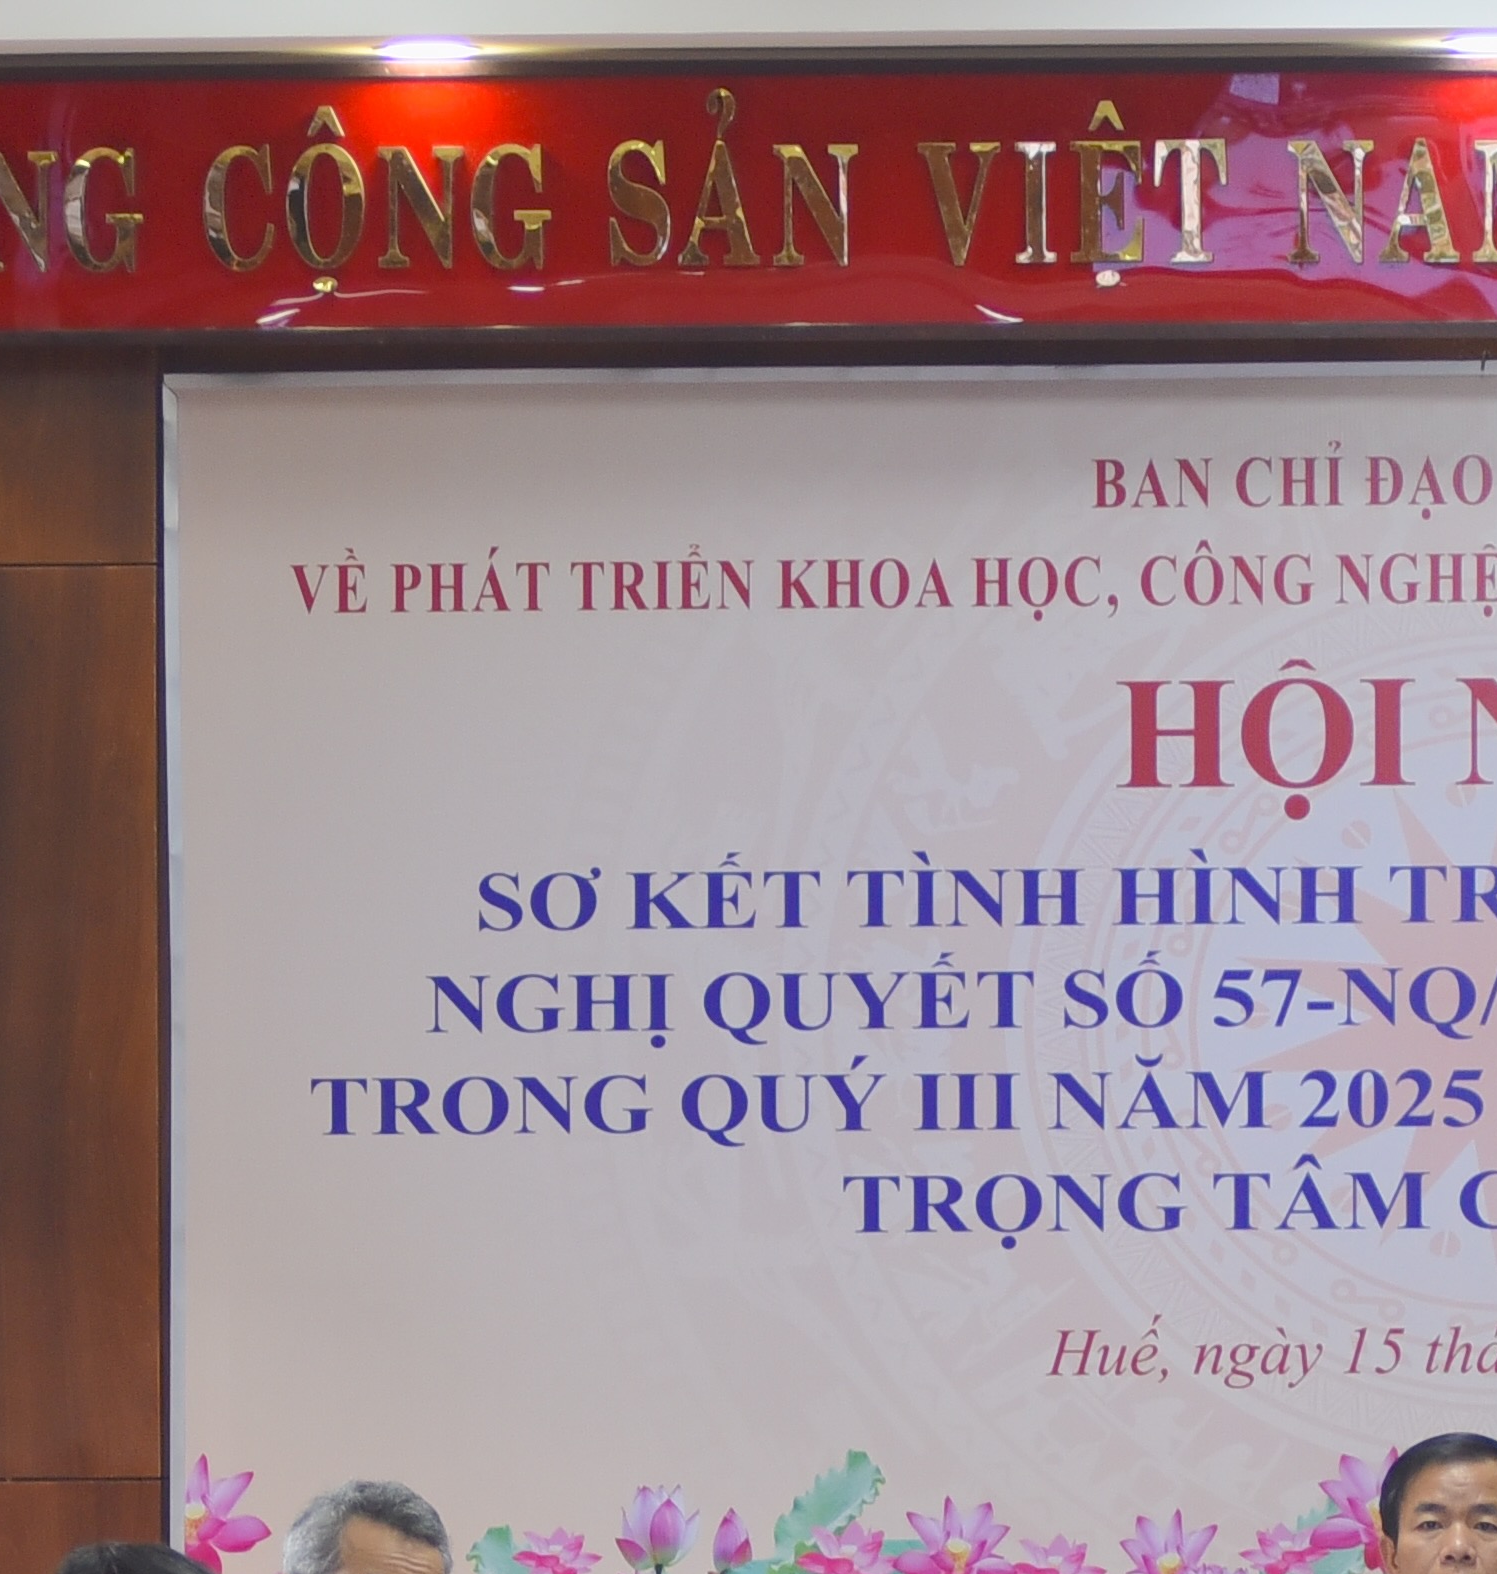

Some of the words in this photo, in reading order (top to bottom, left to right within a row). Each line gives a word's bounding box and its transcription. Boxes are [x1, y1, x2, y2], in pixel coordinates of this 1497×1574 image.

[204, 106, 546, 295] CỘNG
[606, 88, 859, 268] SẢN
[917, 99, 1228, 287] VIỆT
[1091, 457, 1212, 509] BAN
[1232, 440, 1344, 508] CHỈ
[1363, 453, 1496, 521] ĐẠO
[289, 547, 370, 615] VỀ
[391, 545, 553, 614] PHÁT
[567, 544, 753, 612] TRIỂN
[777, 558, 954, 610] KHOA
[972, 555, 1121, 622] HỌC,
[1137, 538, 1315, 607] CÔNG
[1119, 658, 1411, 822] HỘI
[475, 866, 604, 932] SƠ
[629, 851, 824, 931] KẾT
[843, 849, 1081, 929] TÌNH
[1115, 847, 1359, 927] HÌNH
[428, 973, 671, 1050] NGHỊ
[700, 951, 1037, 1047] QUYẾT
[1061, 949, 1186, 1029] SỐ
[307, 1074, 651, 1137] TRONG
[678, 1054, 885, 1149] QUÝ
[917, 1072, 1017, 1132] III
[1049, 1054, 1268, 1131] NĂM
[1298, 1068, 1487, 1129] 2025
[840, 1172, 1185, 1251] TRỌNG
[1210, 1152, 1427, 1232] TÂM
[1046, 1313, 1172, 1381] Huế,
[1191, 1326, 1326, 1389] ngày
[1344, 1326, 1408, 1376] 15
